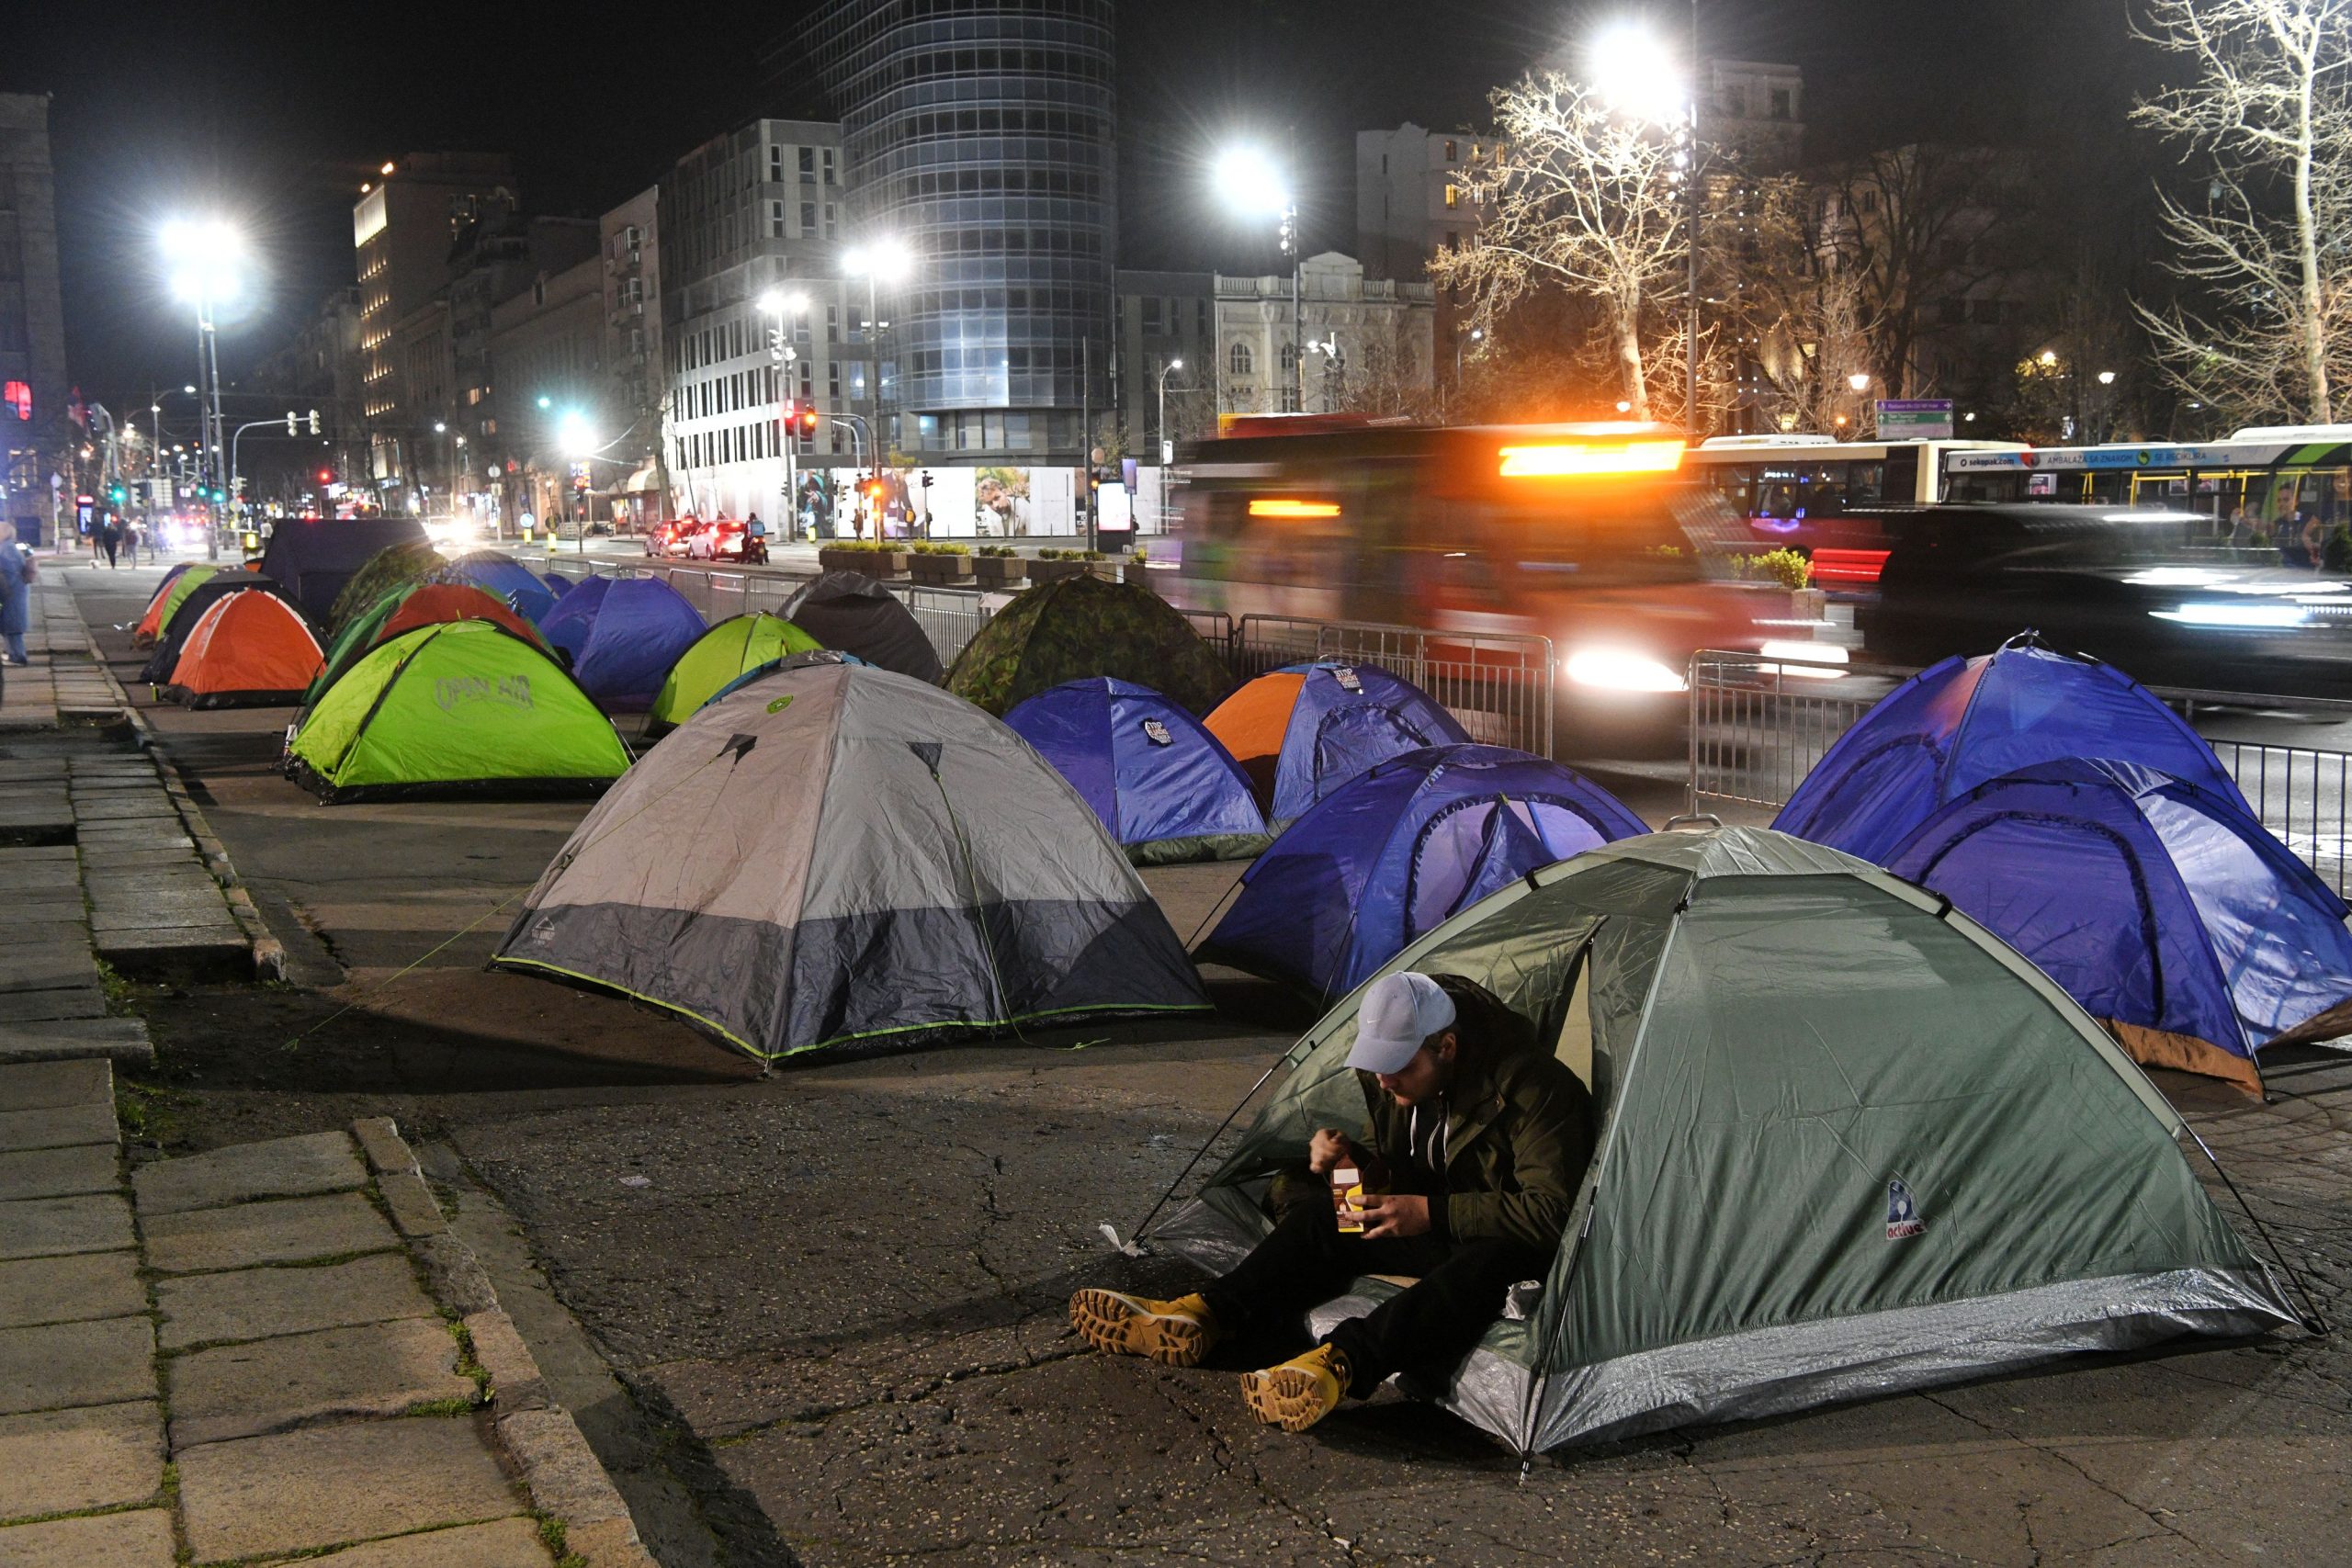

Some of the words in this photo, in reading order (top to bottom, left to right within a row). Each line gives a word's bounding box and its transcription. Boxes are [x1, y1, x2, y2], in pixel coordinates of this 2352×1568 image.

[2047, 455, 2086, 465] AMBALAŽA
[2100, 454, 2133, 463] ZNAKOM
[435, 676, 489, 712] OPEN
[498, 675, 534, 709] AIR
[1887, 1222, 1924, 1238] active
